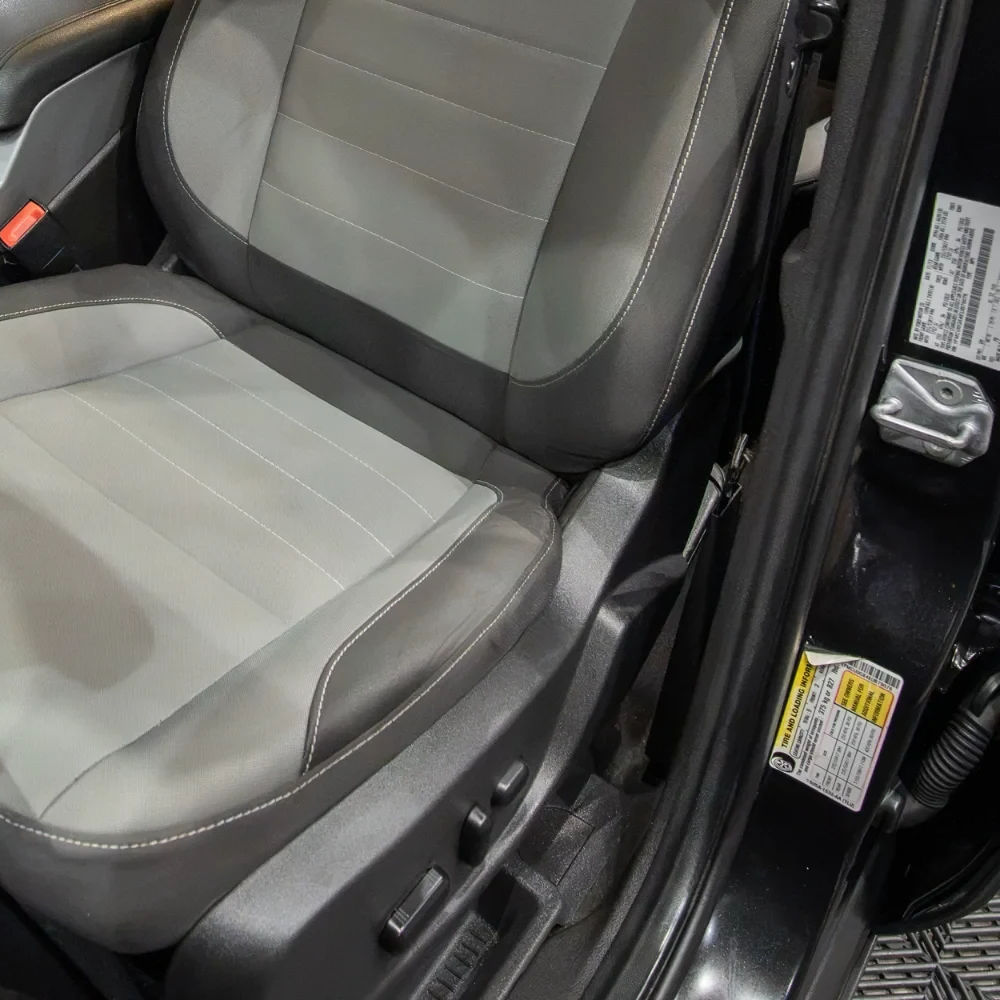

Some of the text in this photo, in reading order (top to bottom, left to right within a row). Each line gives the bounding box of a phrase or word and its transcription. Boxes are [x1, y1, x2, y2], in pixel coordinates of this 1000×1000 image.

[826, 676, 834, 689] 827
[821, 695, 830, 704] kg
[825, 689, 831, 697] or
[840, 677, 855, 707] SEE OWNERS
[850, 682, 865, 712] MANUAL FOR
[790, 687, 804, 718] LOADING
[817, 703, 826, 715] 375
[786, 717, 795, 732] AND
[780, 732, 790, 748] TIRE
